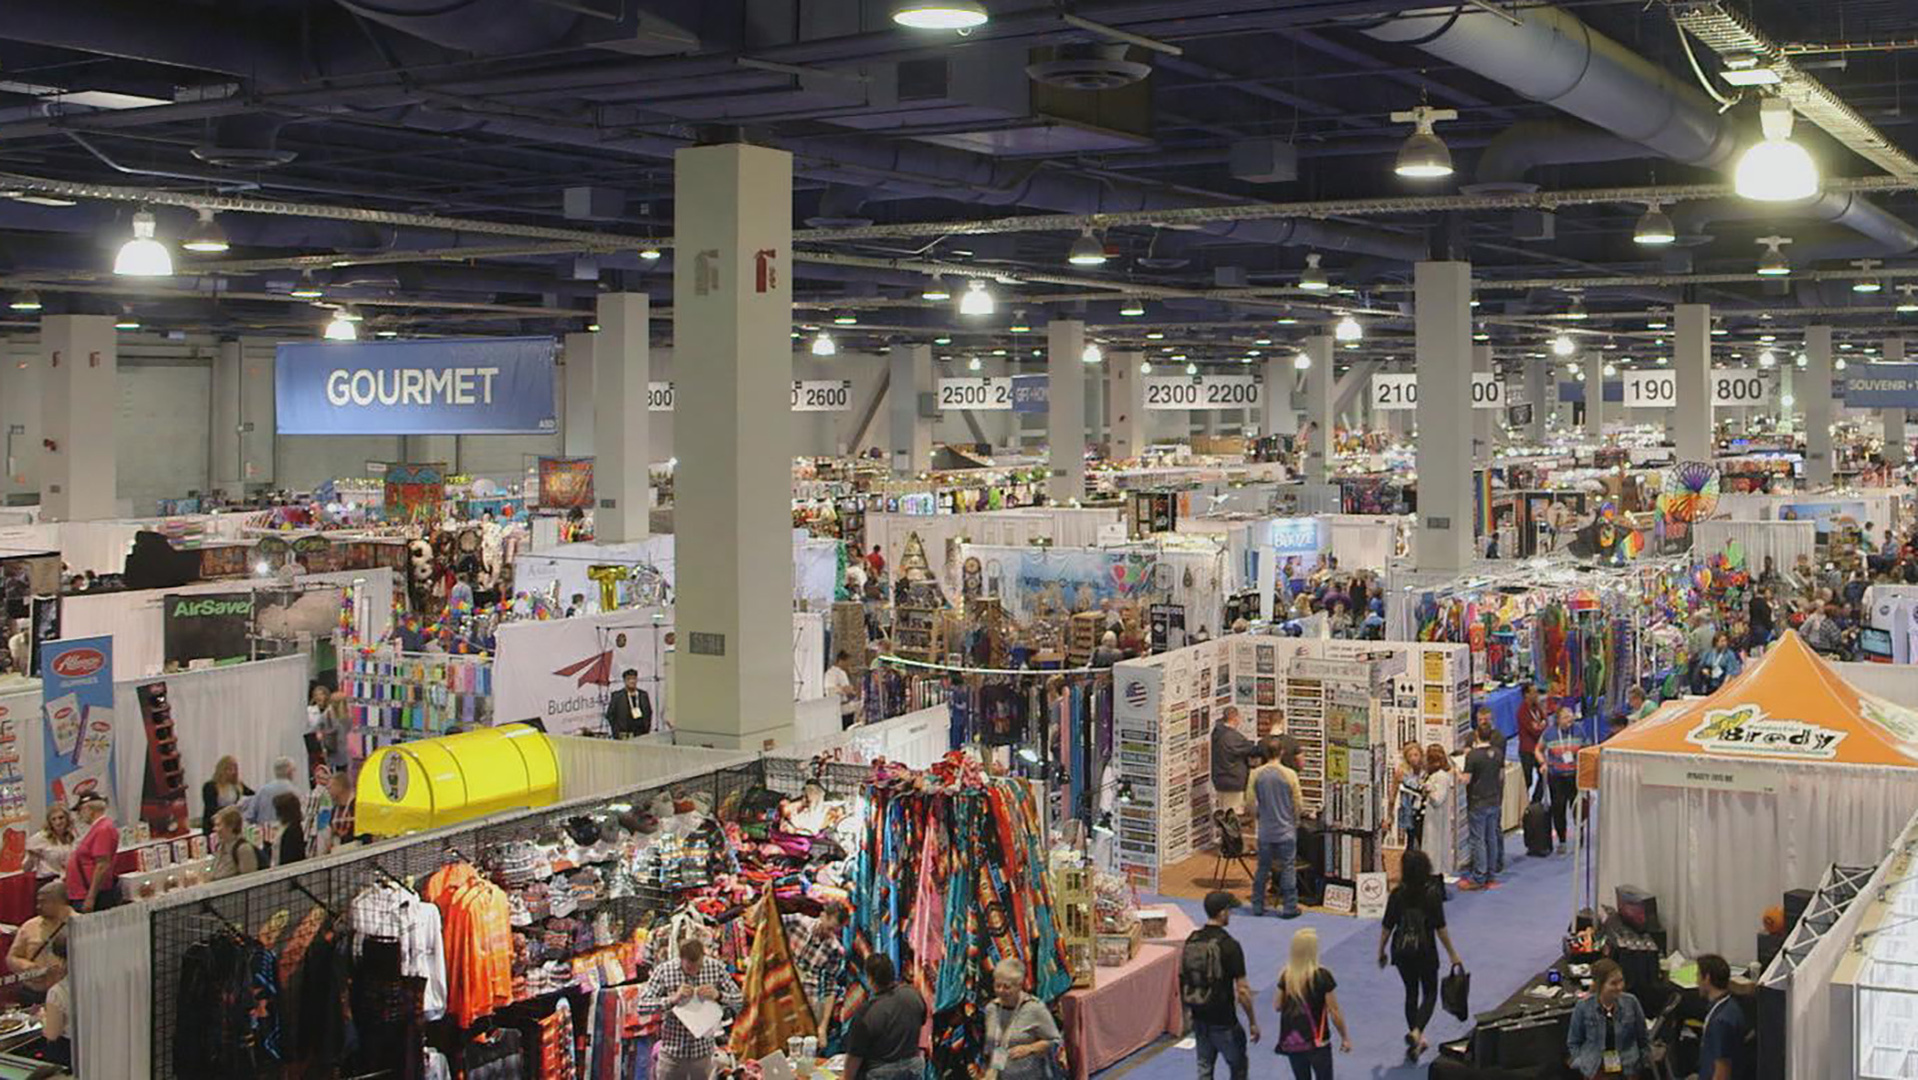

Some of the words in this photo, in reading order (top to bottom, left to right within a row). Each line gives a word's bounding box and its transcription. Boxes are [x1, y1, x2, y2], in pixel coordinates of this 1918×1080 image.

[327, 367, 499, 406] GOURMET
[995, 386, 1014, 403] 24
[1149, 384, 1197, 403] 2300
[1208, 384, 1258, 403] 2200
[1378, 383, 1417, 403] 210
[1472, 382, 1499, 402] 00
[1630, 379, 1674, 400] 190
[1717, 378, 1762, 400] 800
[1849, 379, 1907, 391] SOUVENIR
[806, 388, 847, 406] 2600
[943, 386, 986, 404] 2500
[173, 599, 252, 617] AirSaver
